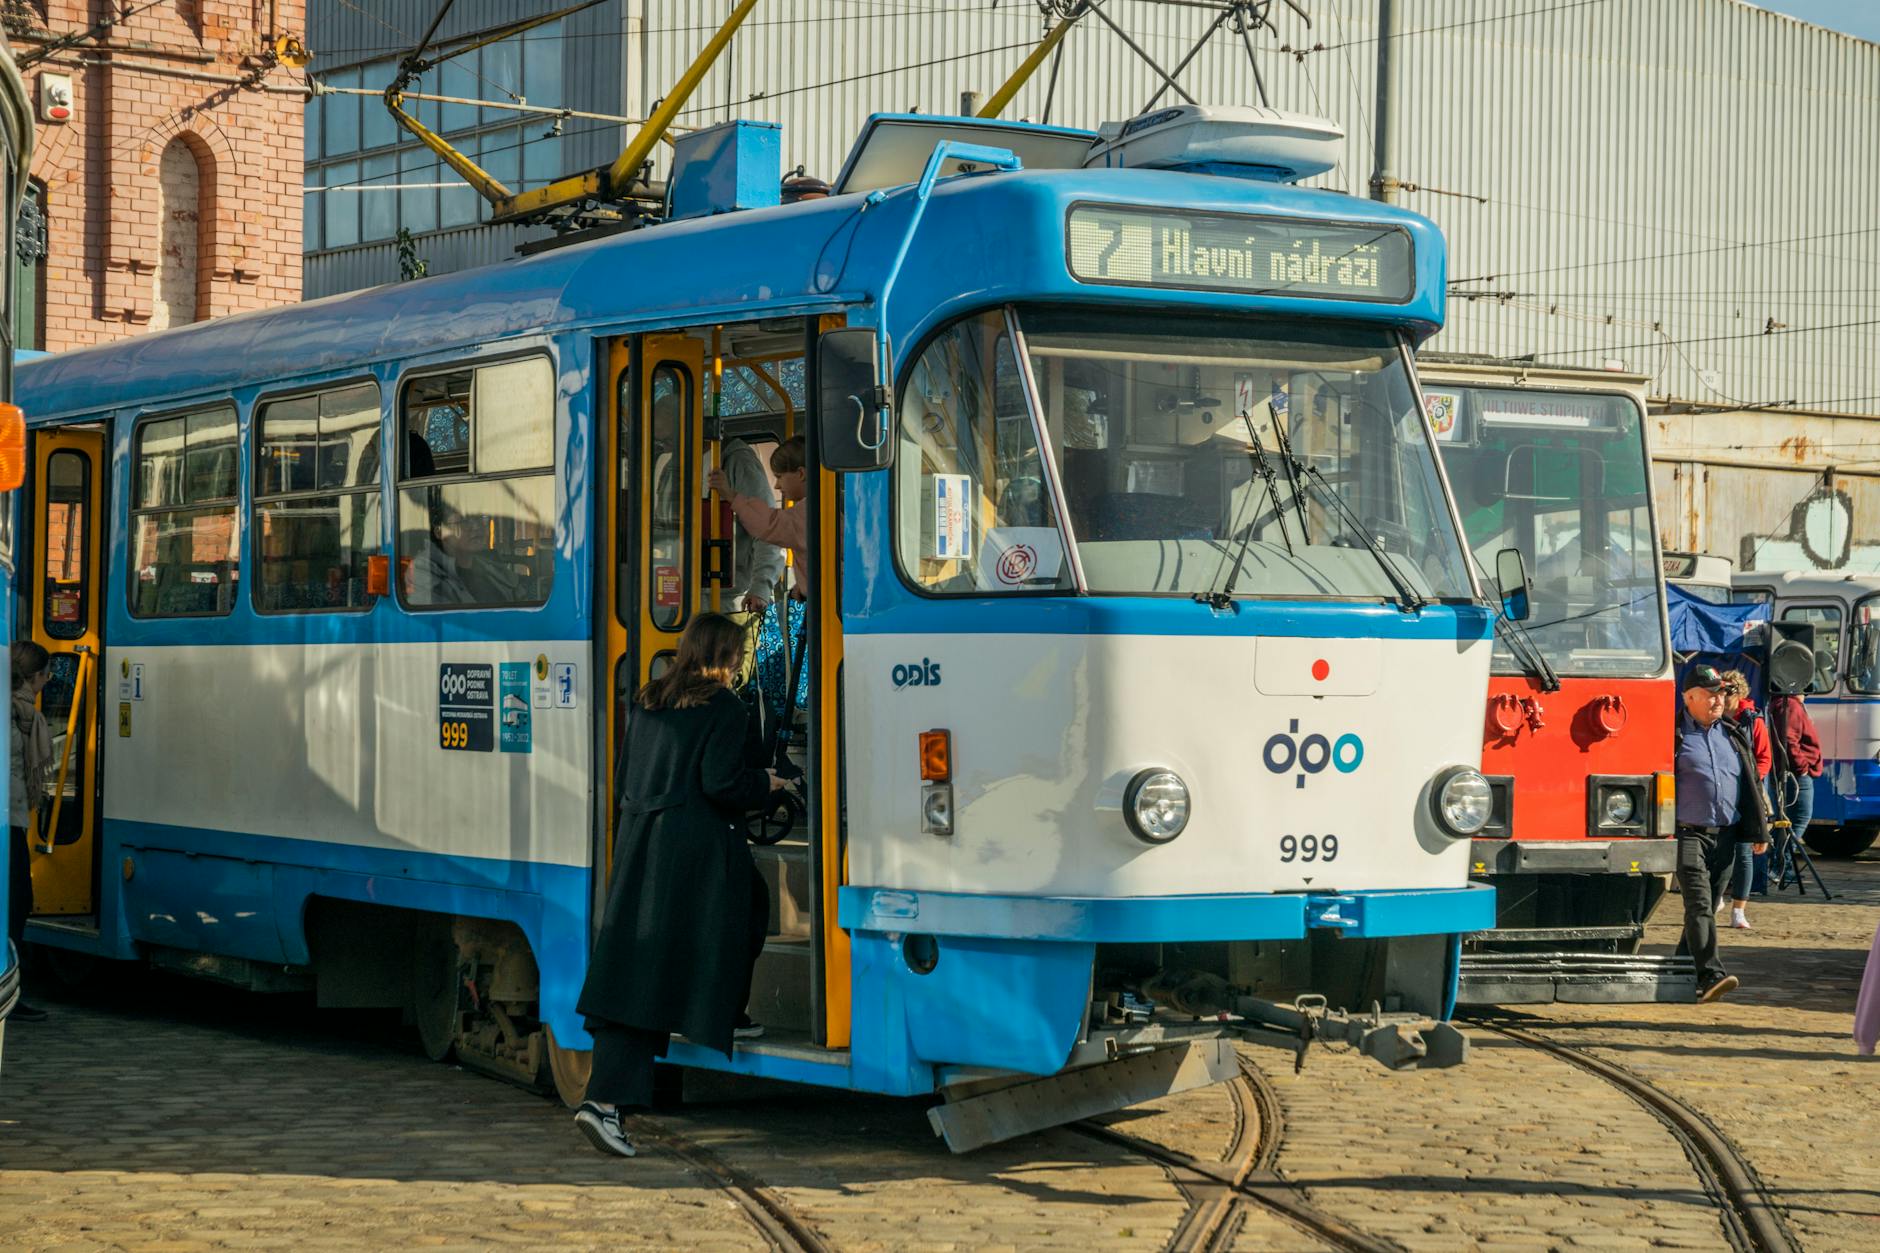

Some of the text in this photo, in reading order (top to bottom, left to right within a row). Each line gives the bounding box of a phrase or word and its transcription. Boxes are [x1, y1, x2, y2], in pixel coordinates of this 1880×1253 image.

[1161, 225, 1256, 279] Hlavní
[1270, 238, 1380, 287] nádraží
[466, 690, 489, 700] OSTRAVA
[442, 722, 468, 747] 999
[1280, 834, 1339, 863] 999
